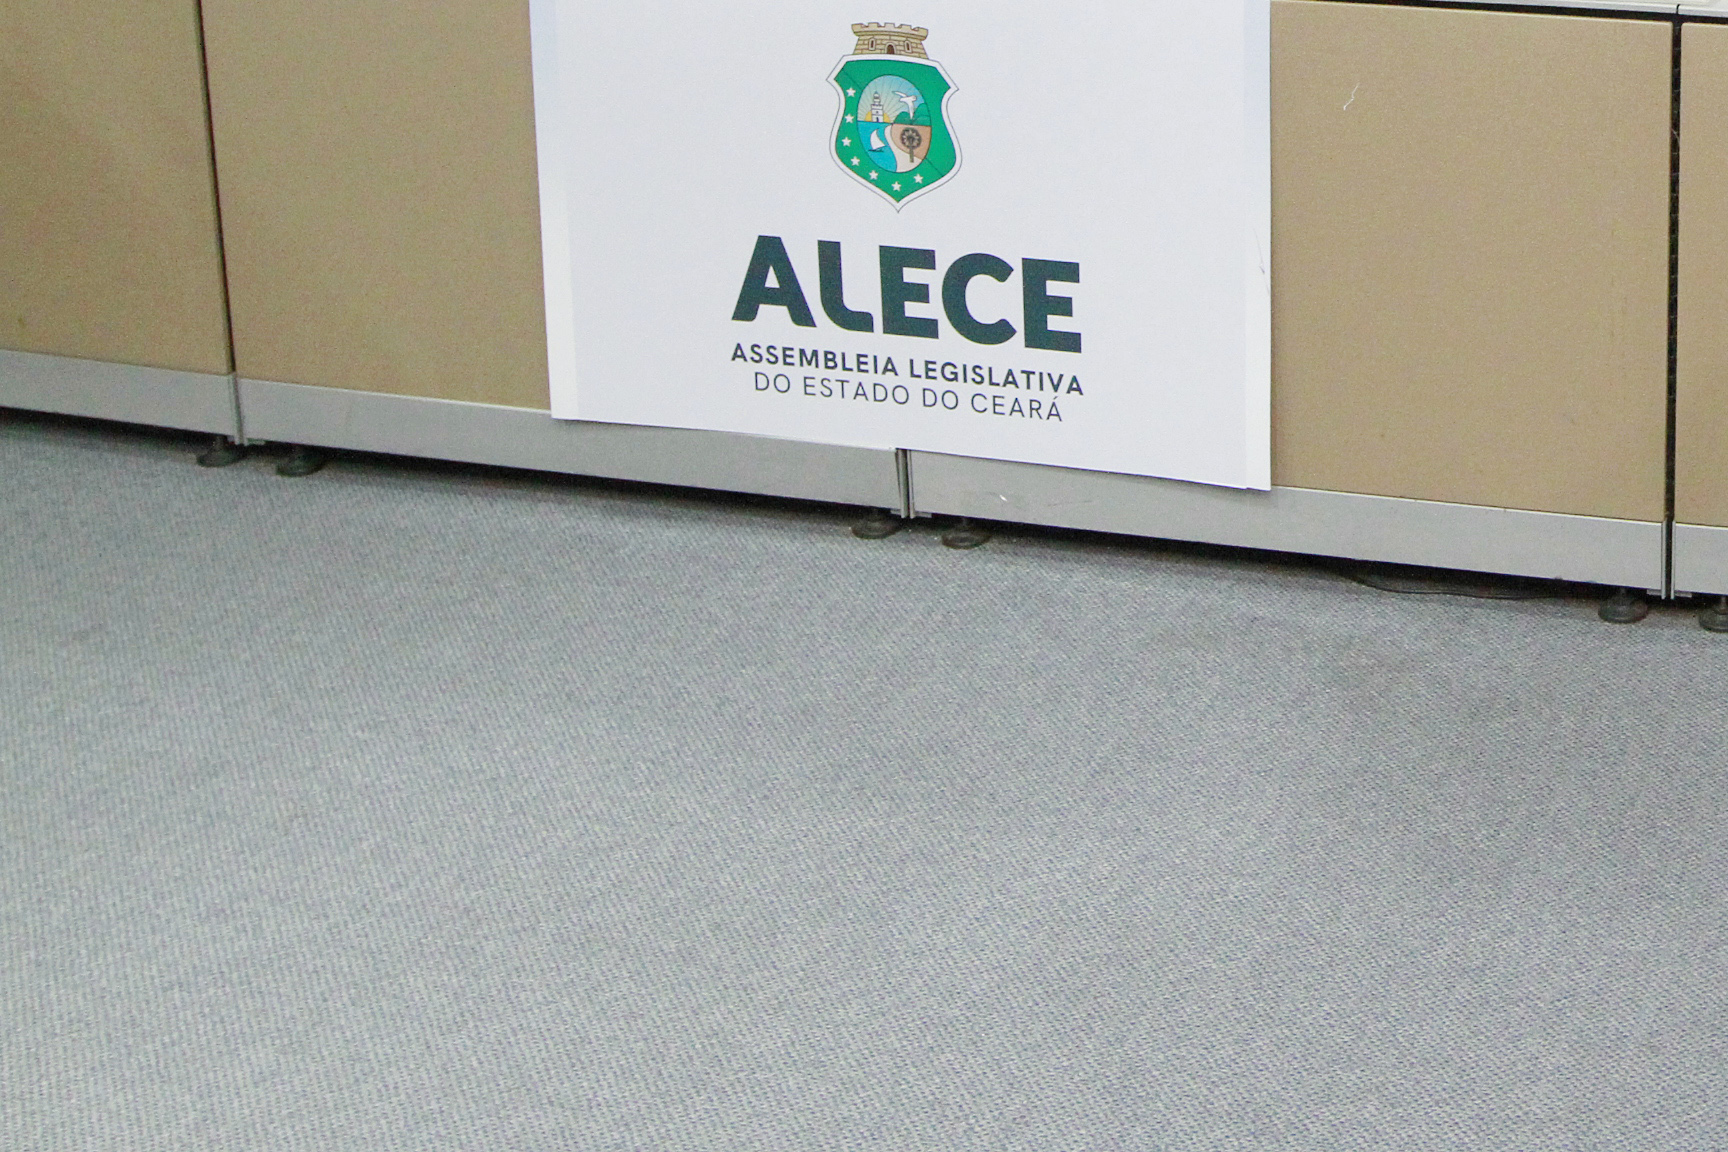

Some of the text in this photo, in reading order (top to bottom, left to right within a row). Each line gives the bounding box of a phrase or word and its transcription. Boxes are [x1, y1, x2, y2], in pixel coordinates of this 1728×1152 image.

[731, 234, 1082, 354] ALECE
[731, 342, 1084, 396] ASSEMBLEIA LEGISLATIVA
[754, 371, 1063, 422] DO ESTADO DO CEARÁ
